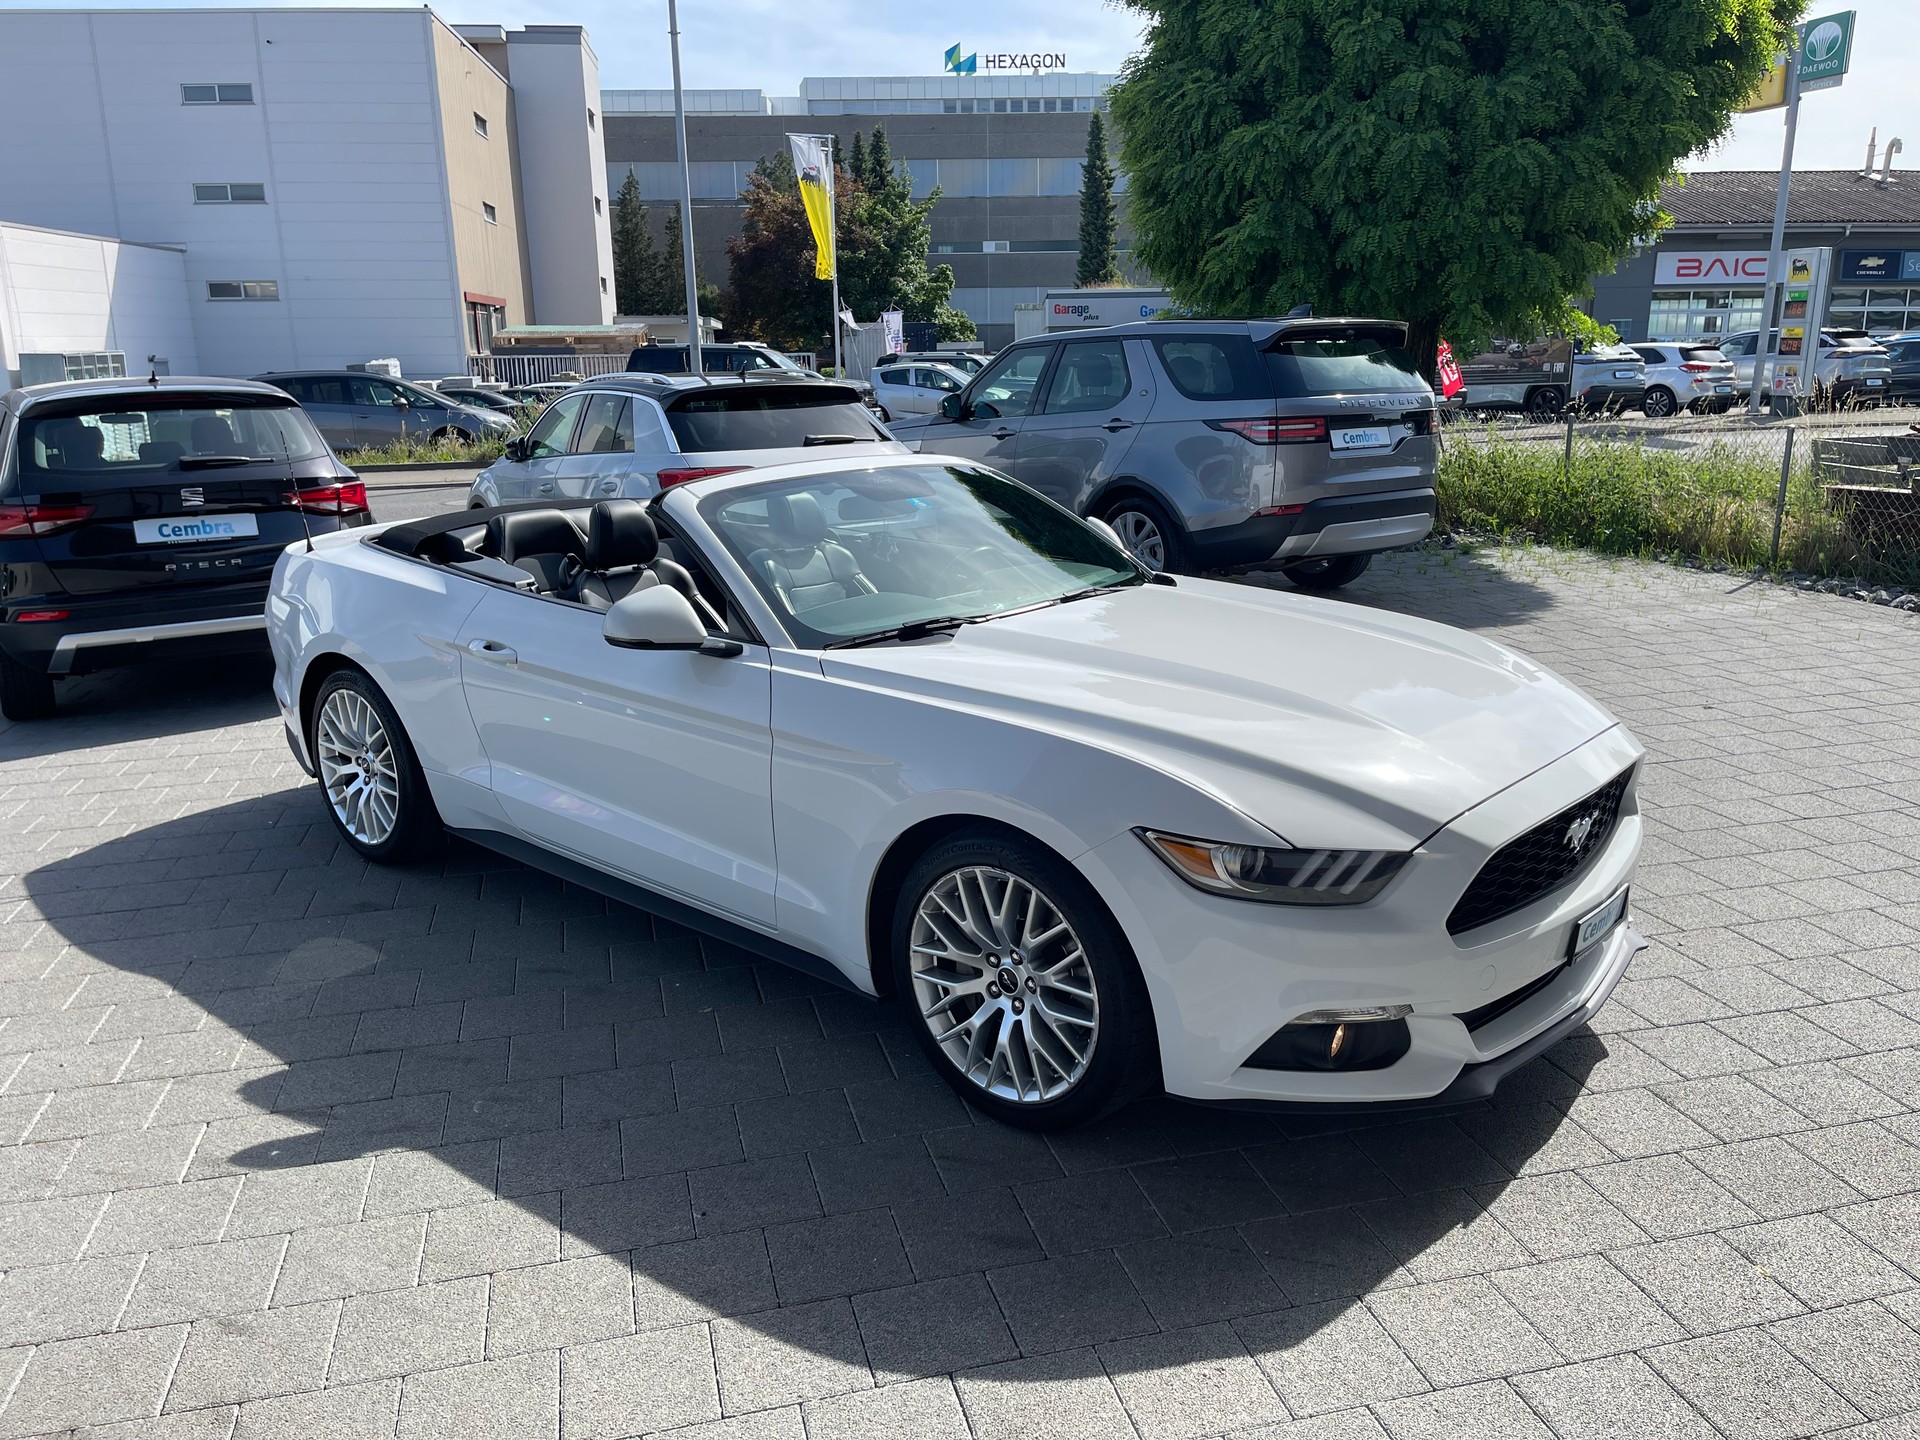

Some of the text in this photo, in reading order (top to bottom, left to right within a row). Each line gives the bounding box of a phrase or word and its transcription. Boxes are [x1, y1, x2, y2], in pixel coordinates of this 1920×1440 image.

[985, 53, 1066, 69] HEXAGON
[1802, 59, 1838, 75] DAEWOO
[1809, 79, 1834, 90] Service
[1676, 257, 1768, 278] BAIC
[1053, 303, 1089, 317] Garage
[1083, 313, 1099, 321] plus
[1339, 397, 1422, 408] DISCOVERY
[1342, 430, 1380, 444] Cembra
[158, 519, 235, 538] Cembra
[165, 558, 243, 572] ATECA
